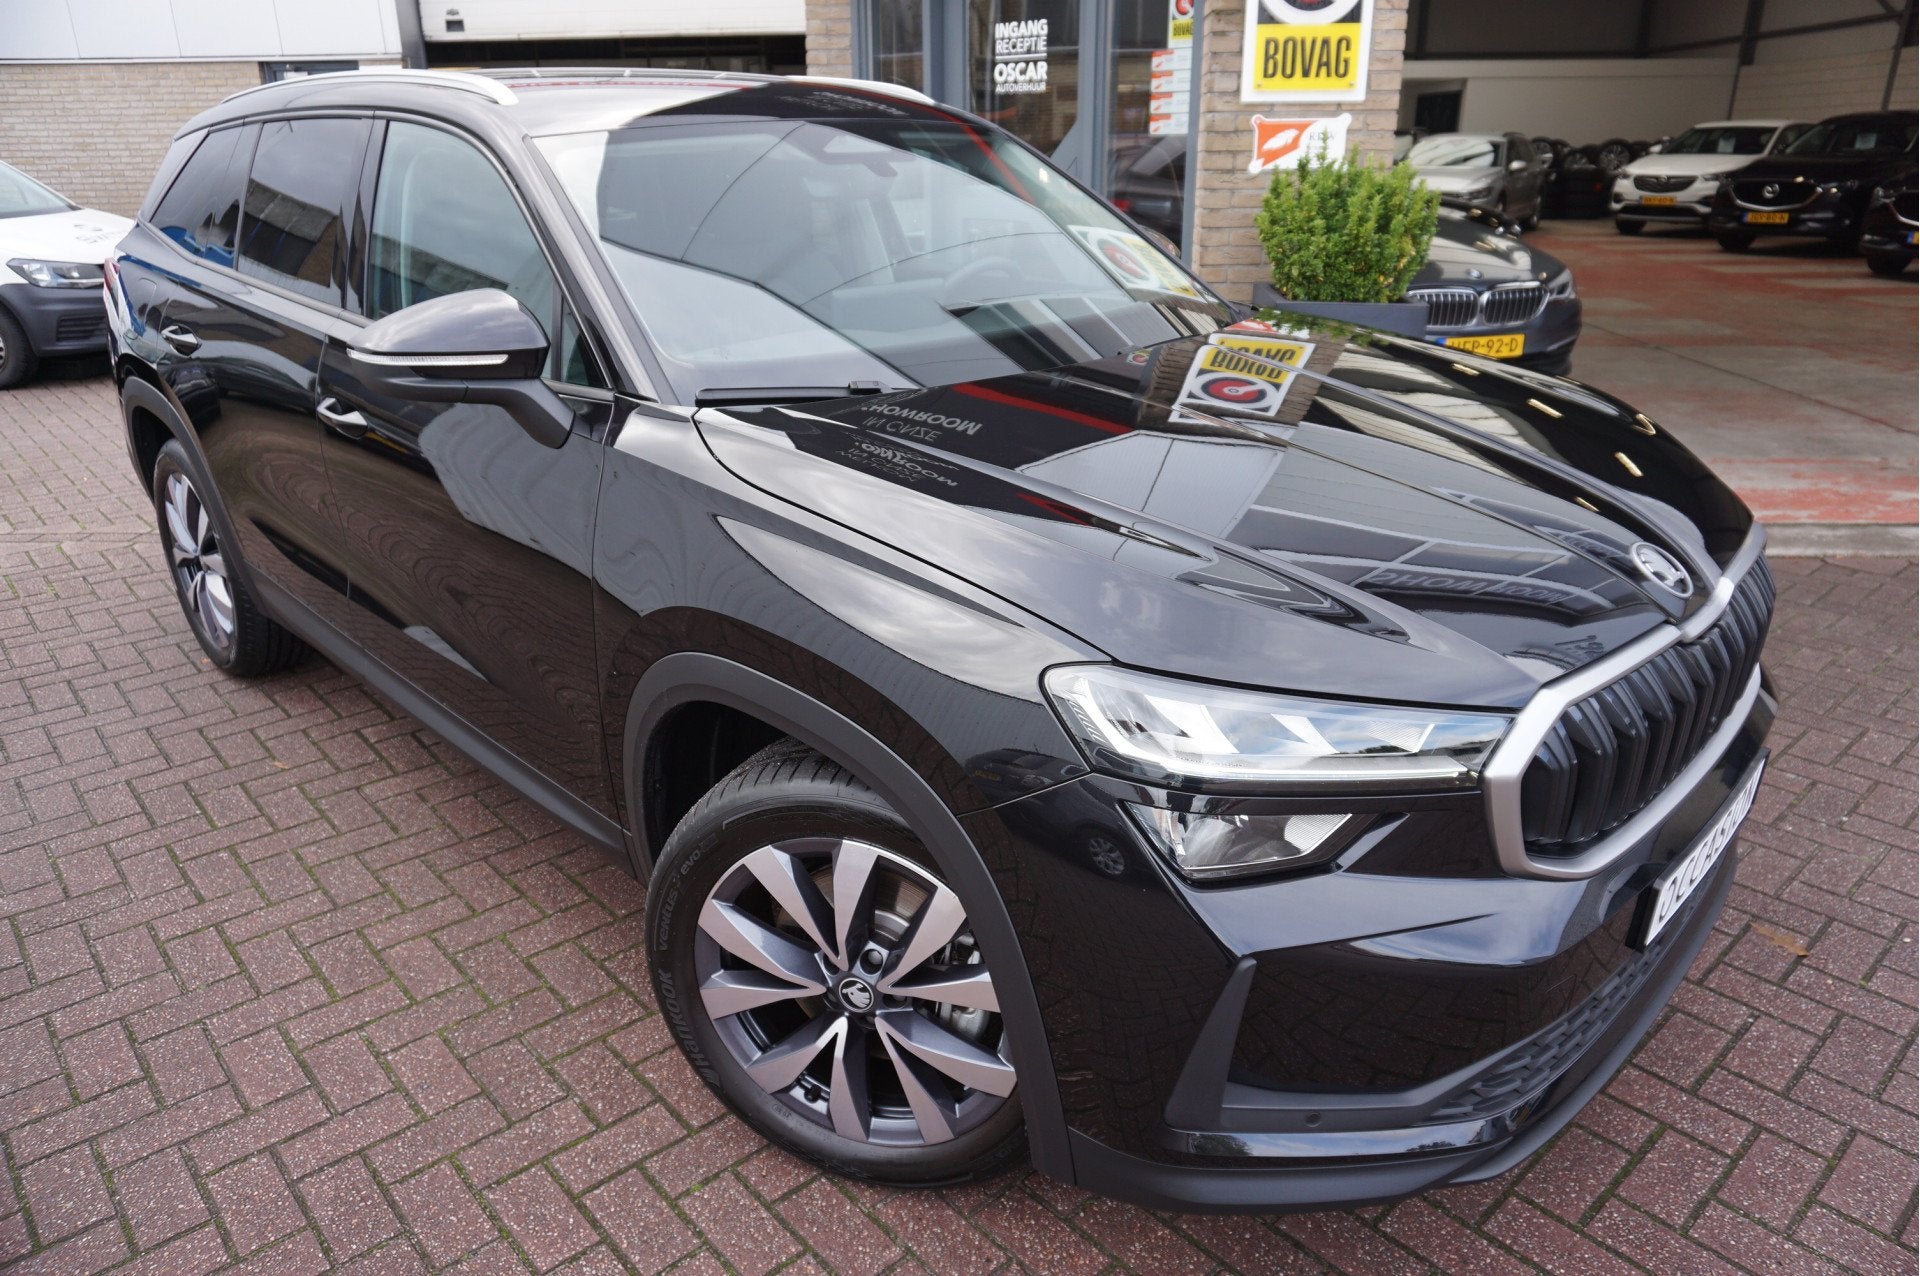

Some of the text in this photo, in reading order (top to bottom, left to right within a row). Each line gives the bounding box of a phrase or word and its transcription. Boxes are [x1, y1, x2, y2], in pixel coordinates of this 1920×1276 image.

[994, 19, 1049, 38] INGANG
[995, 37, 1048, 54] RECEPTIE
[1263, 36, 1352, 79] BOVAG
[994, 61, 1048, 82] OSCAR
[995, 82, 1047, 93] AUTOVERHUUR
